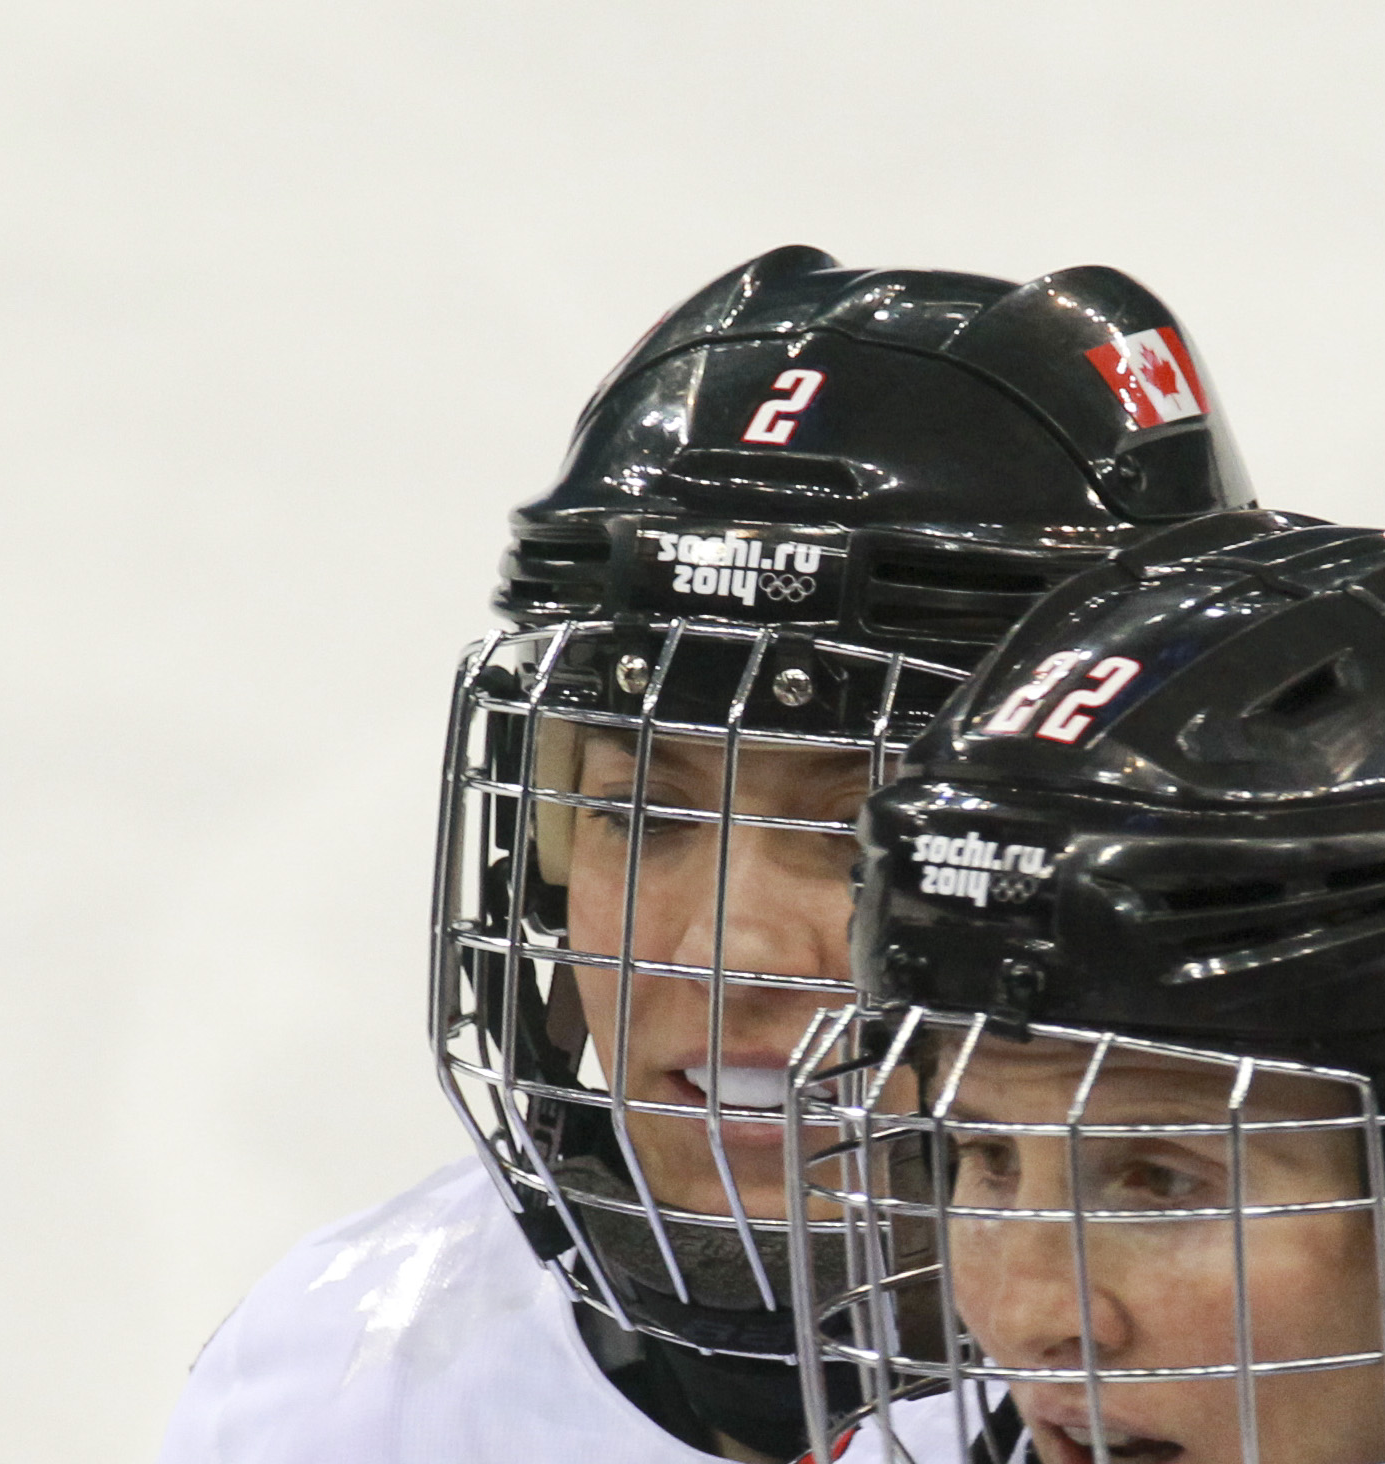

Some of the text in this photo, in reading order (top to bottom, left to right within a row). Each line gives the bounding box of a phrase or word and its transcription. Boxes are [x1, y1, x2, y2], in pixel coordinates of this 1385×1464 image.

[740, 368, 827, 446] 2
[672, 565, 758, 606] 2014
[981, 650, 1143, 744] 22
[912, 832, 1045, 875] sochi.ru
[921, 865, 991, 907] 2014
